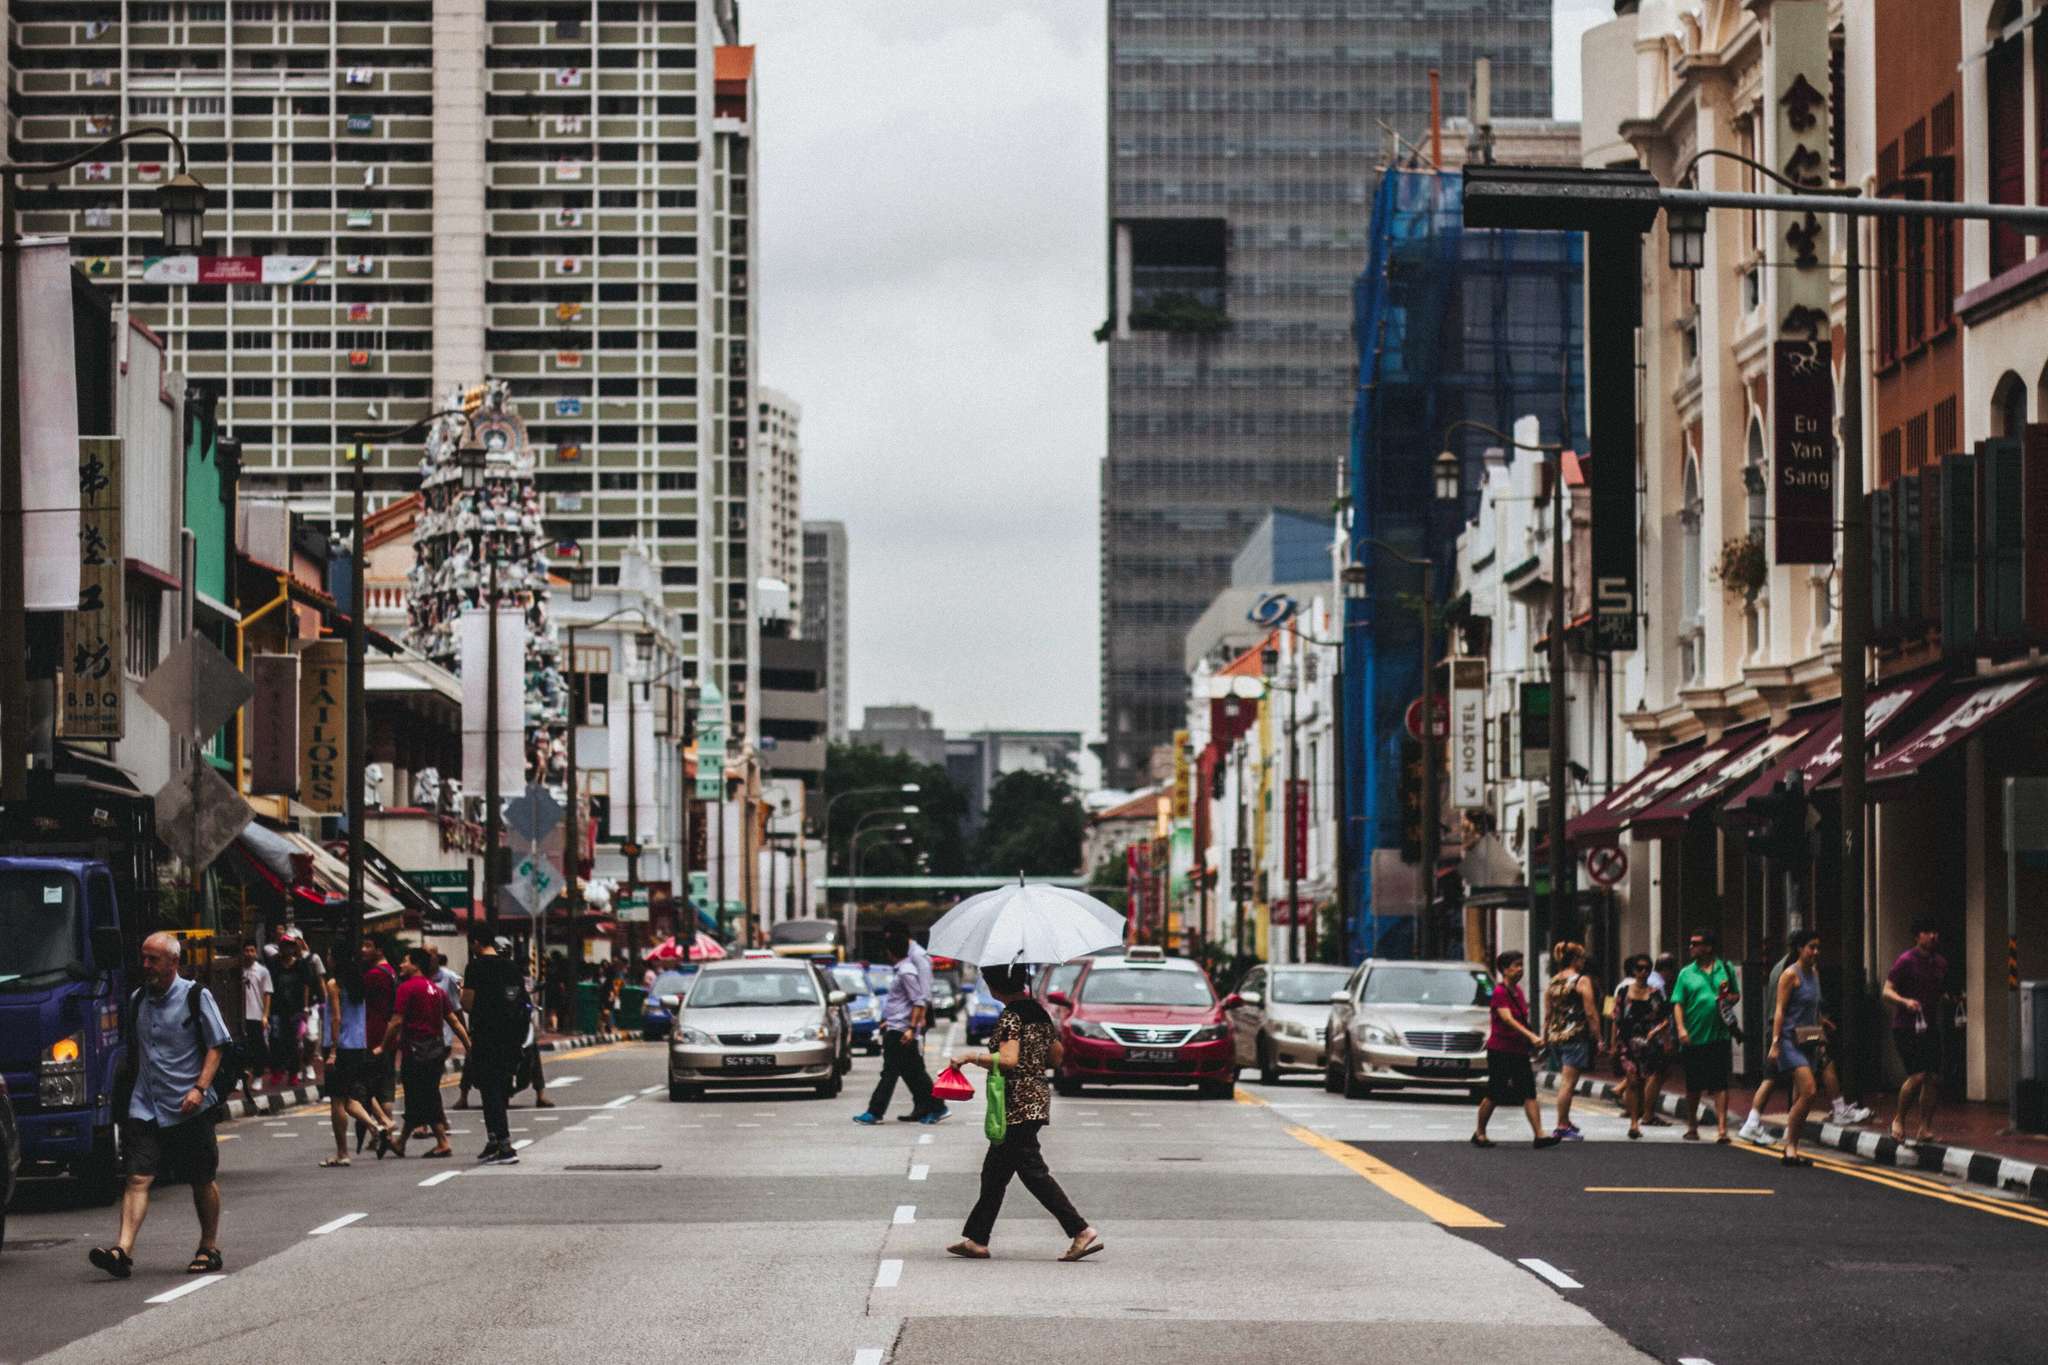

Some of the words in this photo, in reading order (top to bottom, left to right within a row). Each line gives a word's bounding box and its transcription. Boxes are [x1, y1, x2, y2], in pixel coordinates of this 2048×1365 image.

[1795, 415, 1817, 433] Eu
[1791, 441, 1823, 459] Yan
[1784, 466, 1830, 491] Sang
[308, 668, 338, 801] TAILORS
[1463, 703, 1476, 772] HOSTEL
